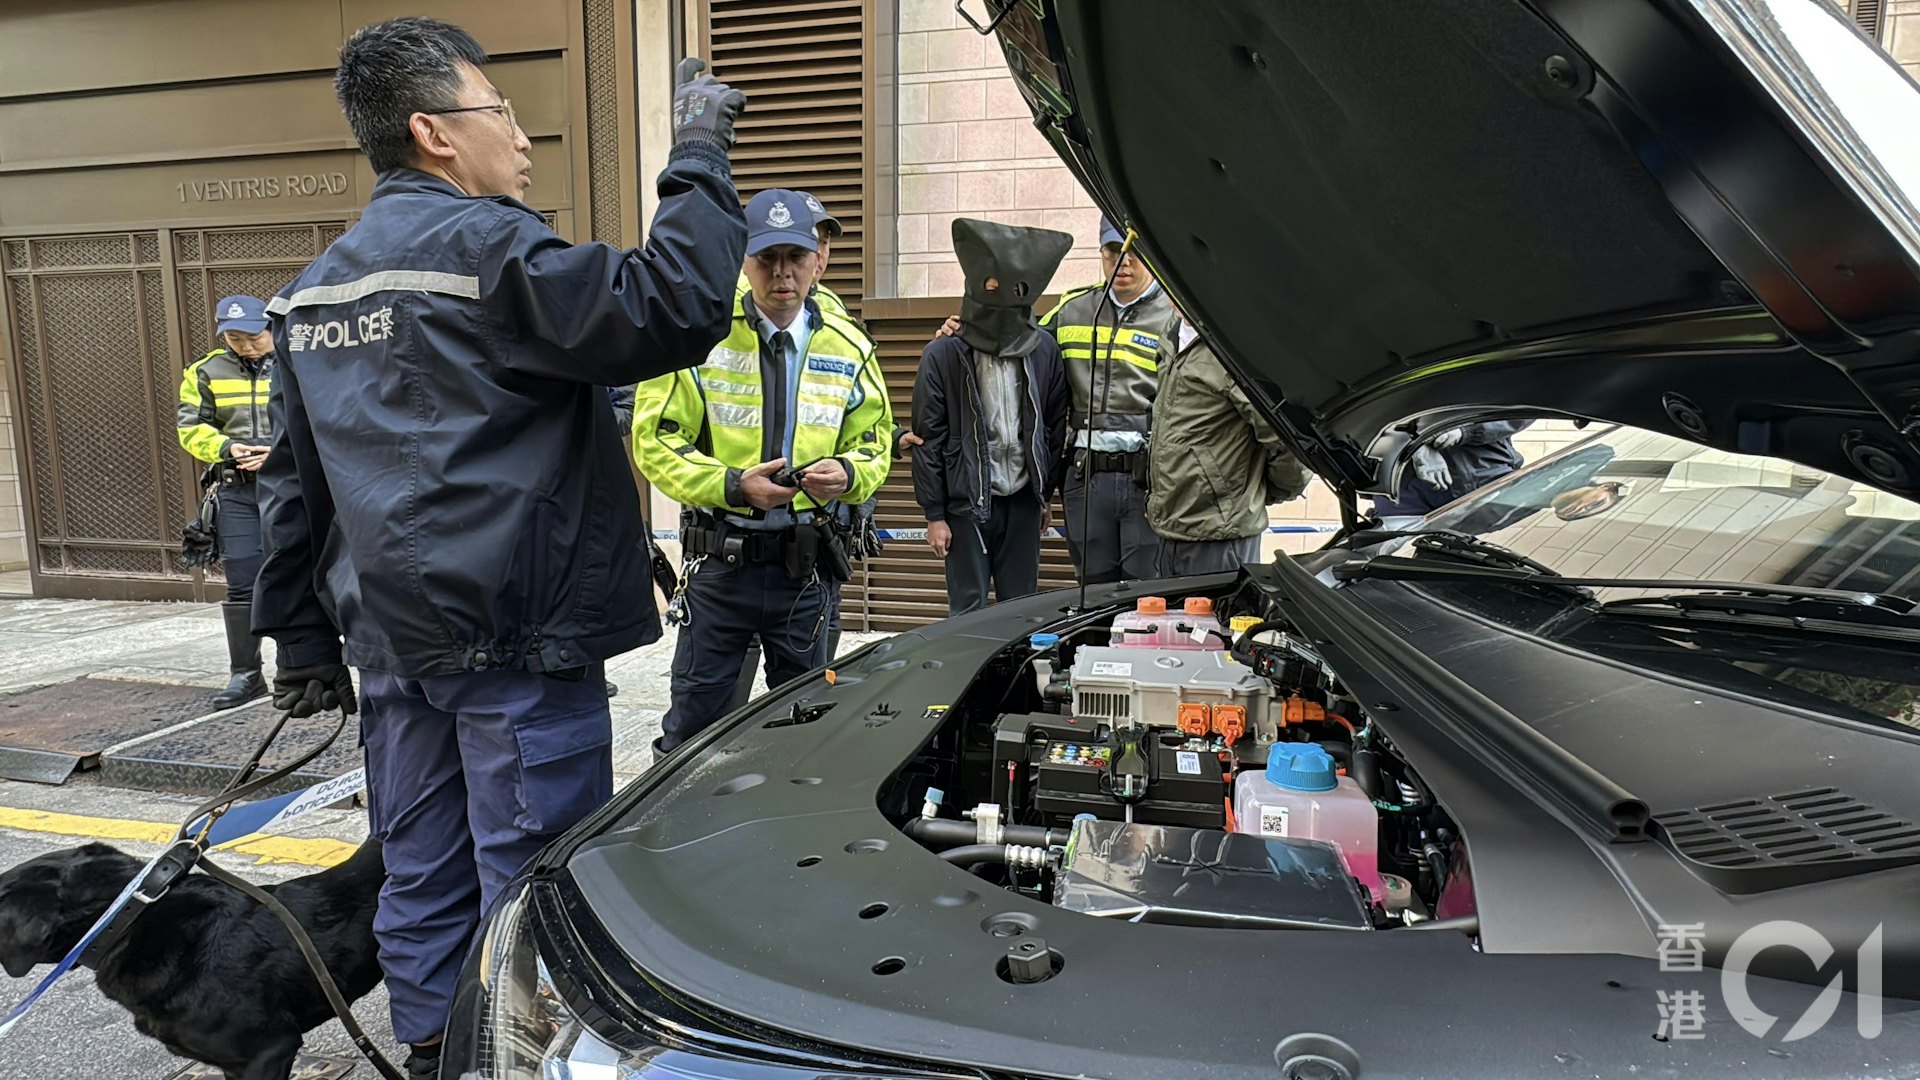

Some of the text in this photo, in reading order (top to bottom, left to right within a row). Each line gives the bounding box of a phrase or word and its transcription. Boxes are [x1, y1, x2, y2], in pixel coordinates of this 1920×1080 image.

[177, 172, 347, 203] 1 VENTRIS ROAD
[310, 312, 381, 350] POLCE
[379, 305, 394, 339] 察
[288, 323, 314, 352] 警
[1140, 336, 1158, 348] POLIC
[819, 360, 846, 372] POLICE
[896, 531, 922, 539] POLICE
